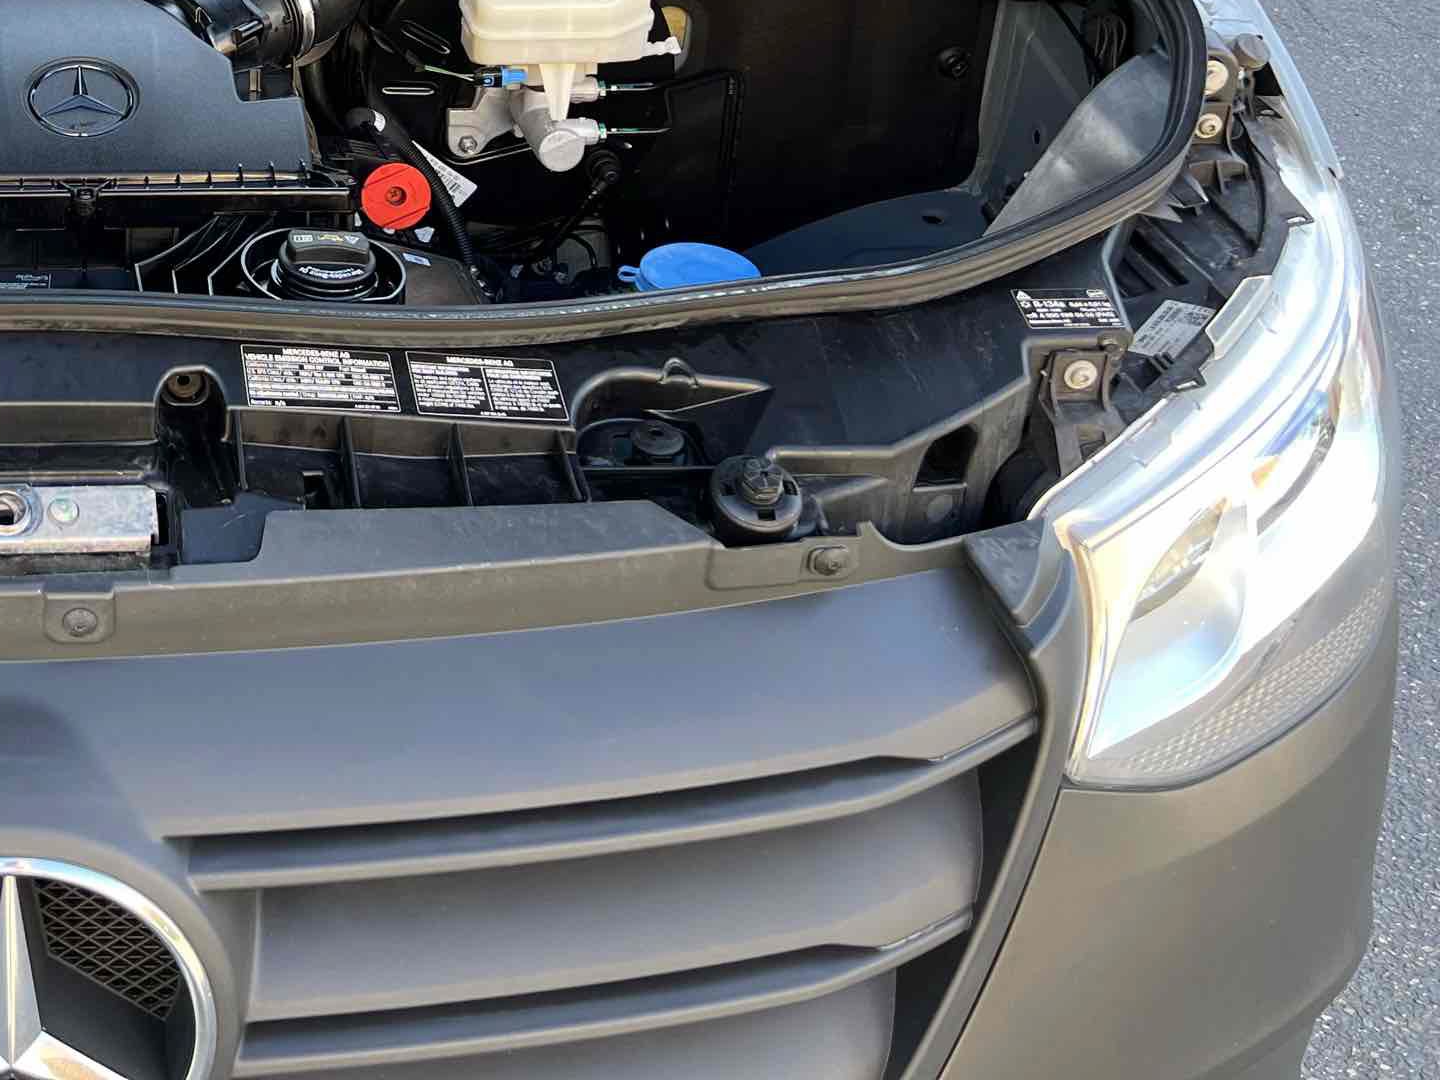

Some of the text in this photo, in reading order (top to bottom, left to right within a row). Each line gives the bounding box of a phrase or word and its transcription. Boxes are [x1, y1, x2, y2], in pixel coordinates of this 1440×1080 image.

[282, 348, 339, 358] MERCEDES-BENZ
[244, 353, 274, 362] VEHICLE
[274, 354, 309, 363] EMISSION
[309, 356, 341, 365] CONTROL
[342, 358, 390, 367] INFORMATION
[446, 356, 502, 366] MERCEDES-BENZ
